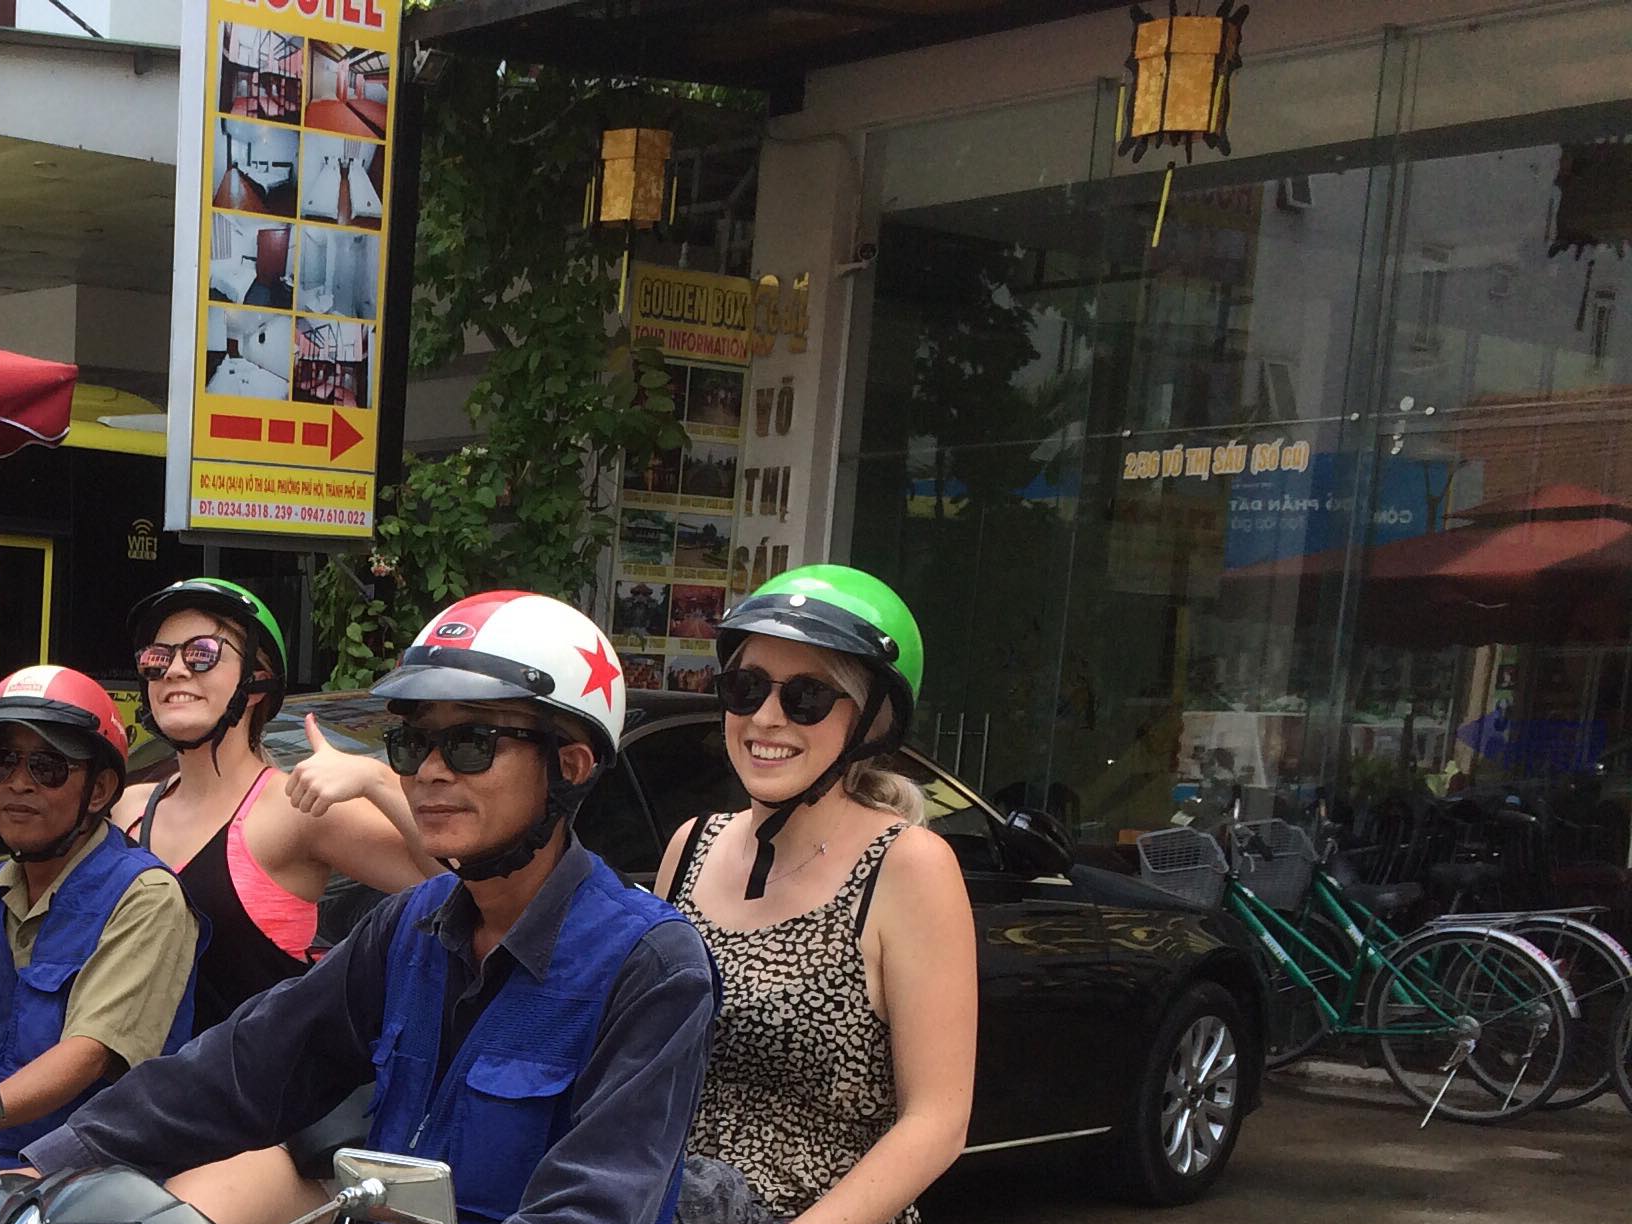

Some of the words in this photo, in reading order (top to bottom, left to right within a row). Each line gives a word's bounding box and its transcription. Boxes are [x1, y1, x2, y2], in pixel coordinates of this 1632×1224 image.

[639, 277, 709, 326] GOLDEN
[712, 287, 751, 332] BOX
[668, 328, 748, 360] INFORMATION
[755, 375, 795, 438] VÕ
[199, 500, 215, 516] ĐT:
[275, 504, 293, 520] 239
[300, 506, 366, 526] 0947.610.022
[744, 464, 792, 523] THỊ
